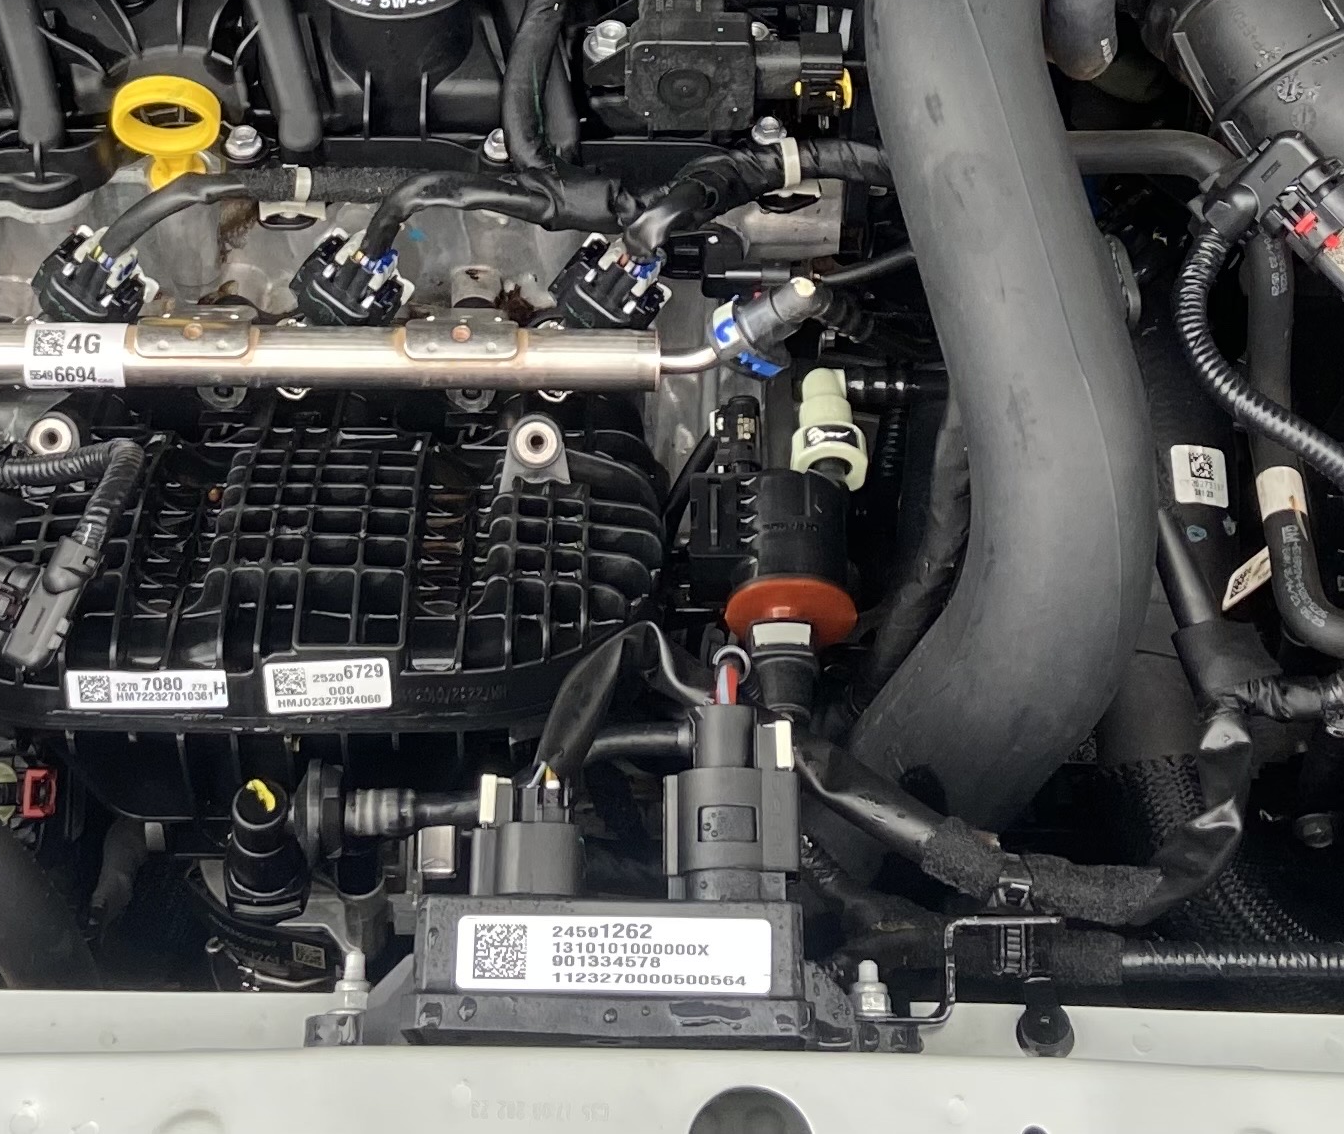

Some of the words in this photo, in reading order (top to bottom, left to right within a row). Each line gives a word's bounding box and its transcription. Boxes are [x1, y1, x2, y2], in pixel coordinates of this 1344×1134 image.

[66, 332, 102, 354] 4G
[115, 682, 139, 692] 1270
[141, 677, 183, 692] 7080
[213, 681, 226, 696] H
[328, 685, 354, 696] 000
